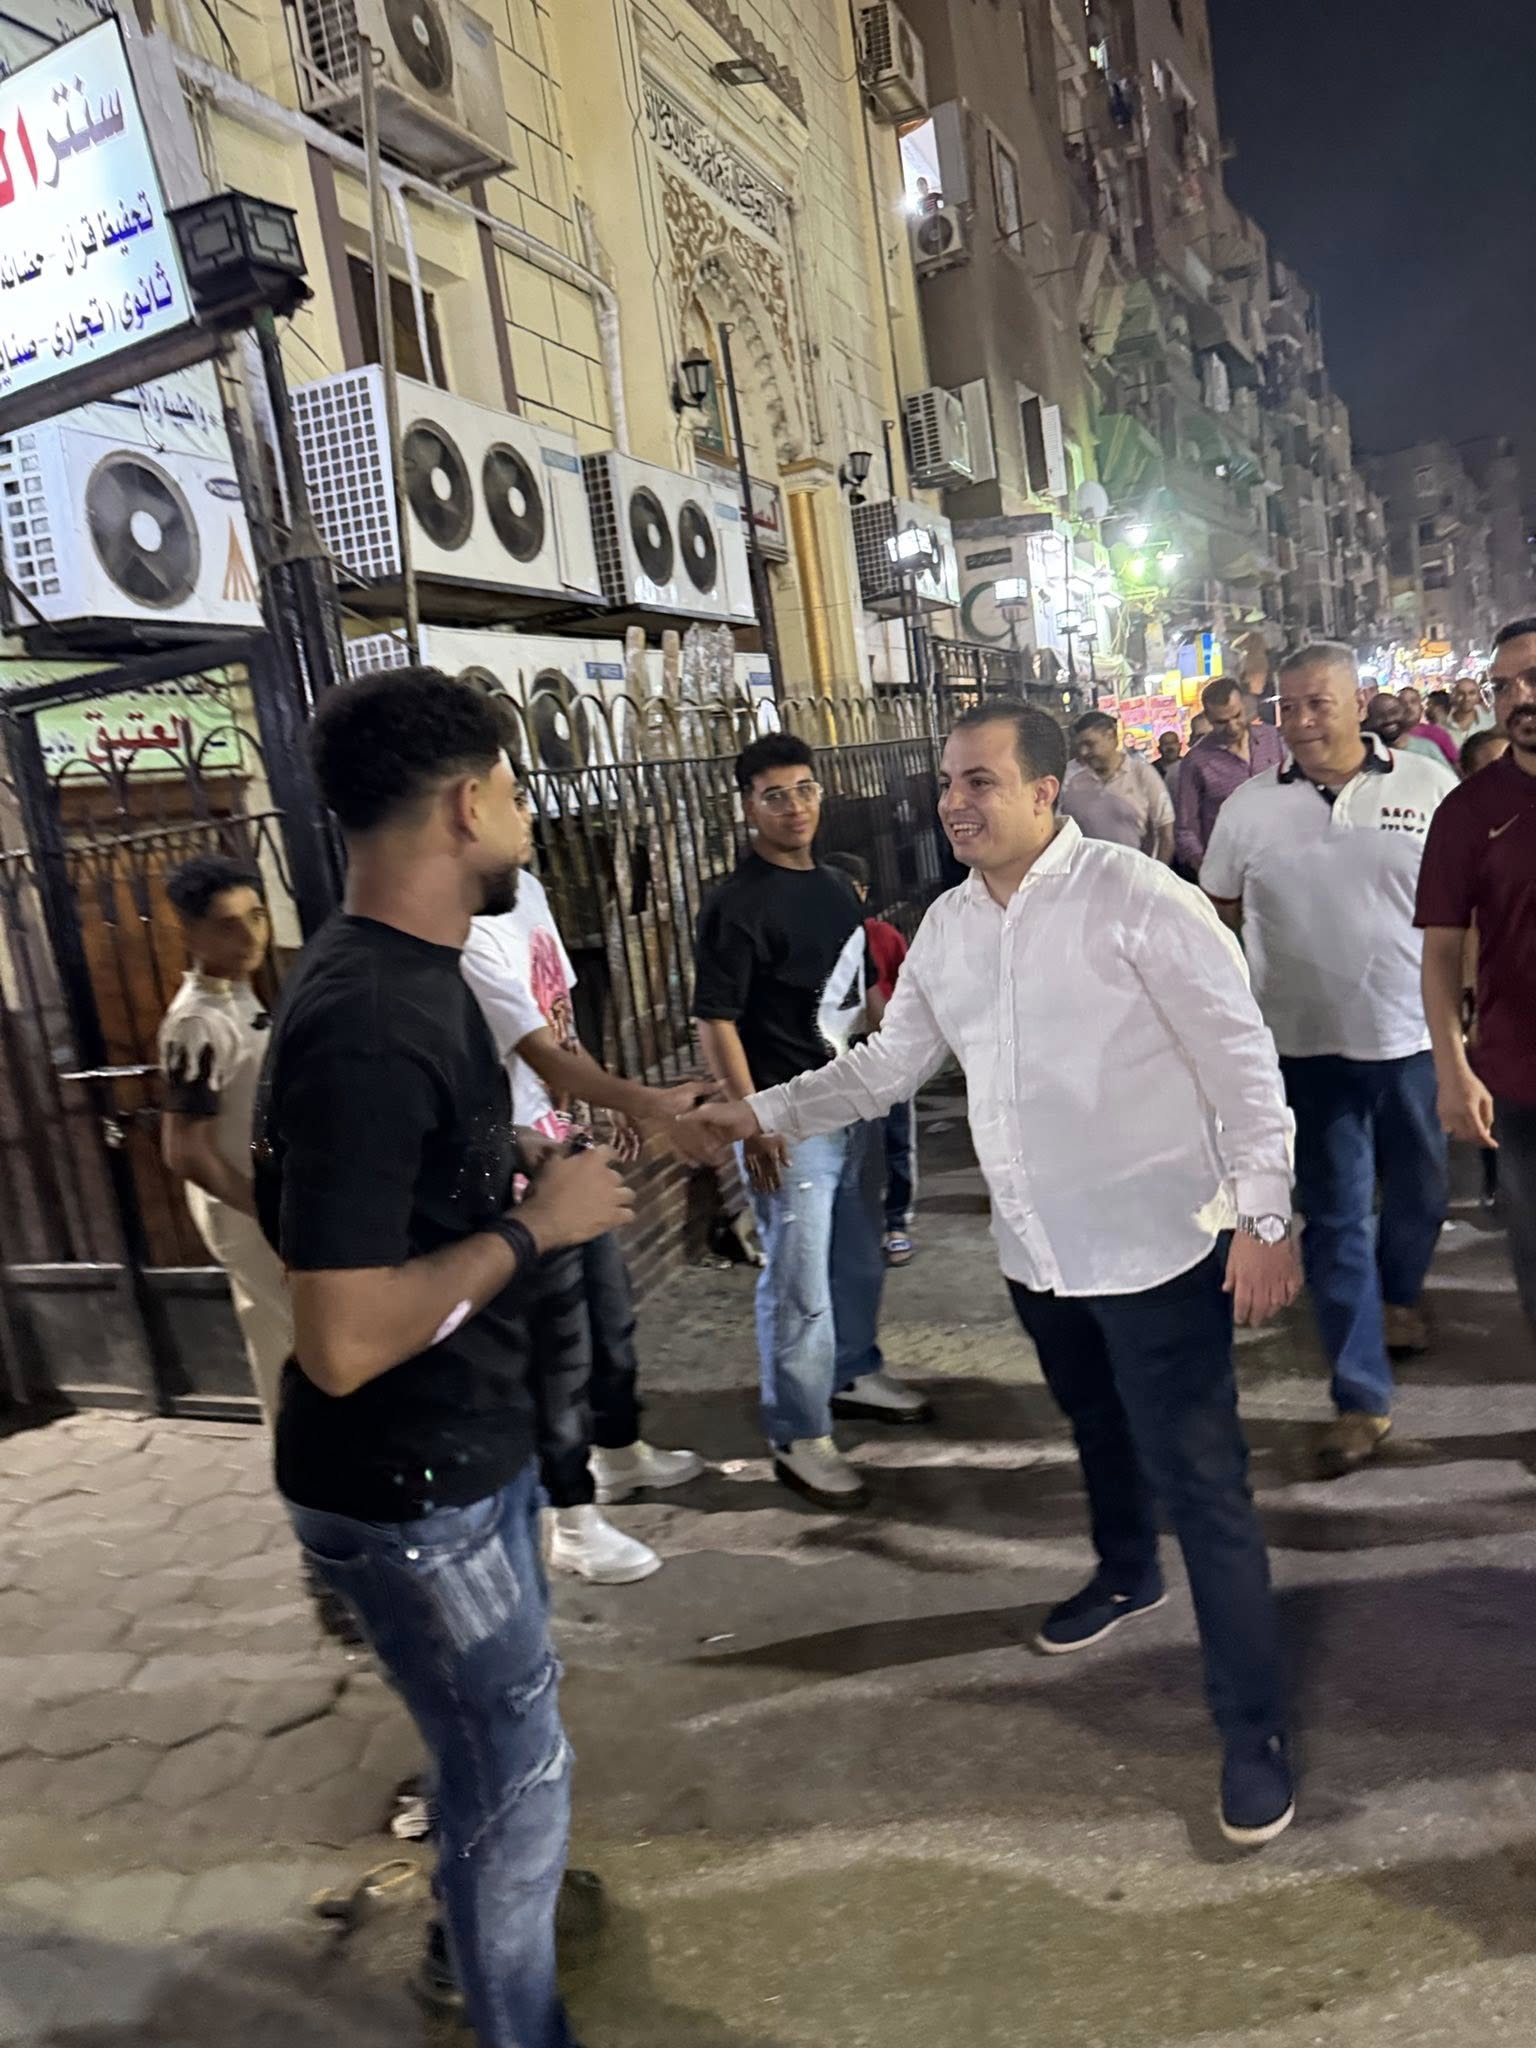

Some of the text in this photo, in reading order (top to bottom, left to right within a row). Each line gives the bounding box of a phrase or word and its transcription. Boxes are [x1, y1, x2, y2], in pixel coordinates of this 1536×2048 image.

[43, 73, 125, 189] سنتر
[97, 190, 153, 256] تحفيظ
[85, 708, 193, 765] العتيق
